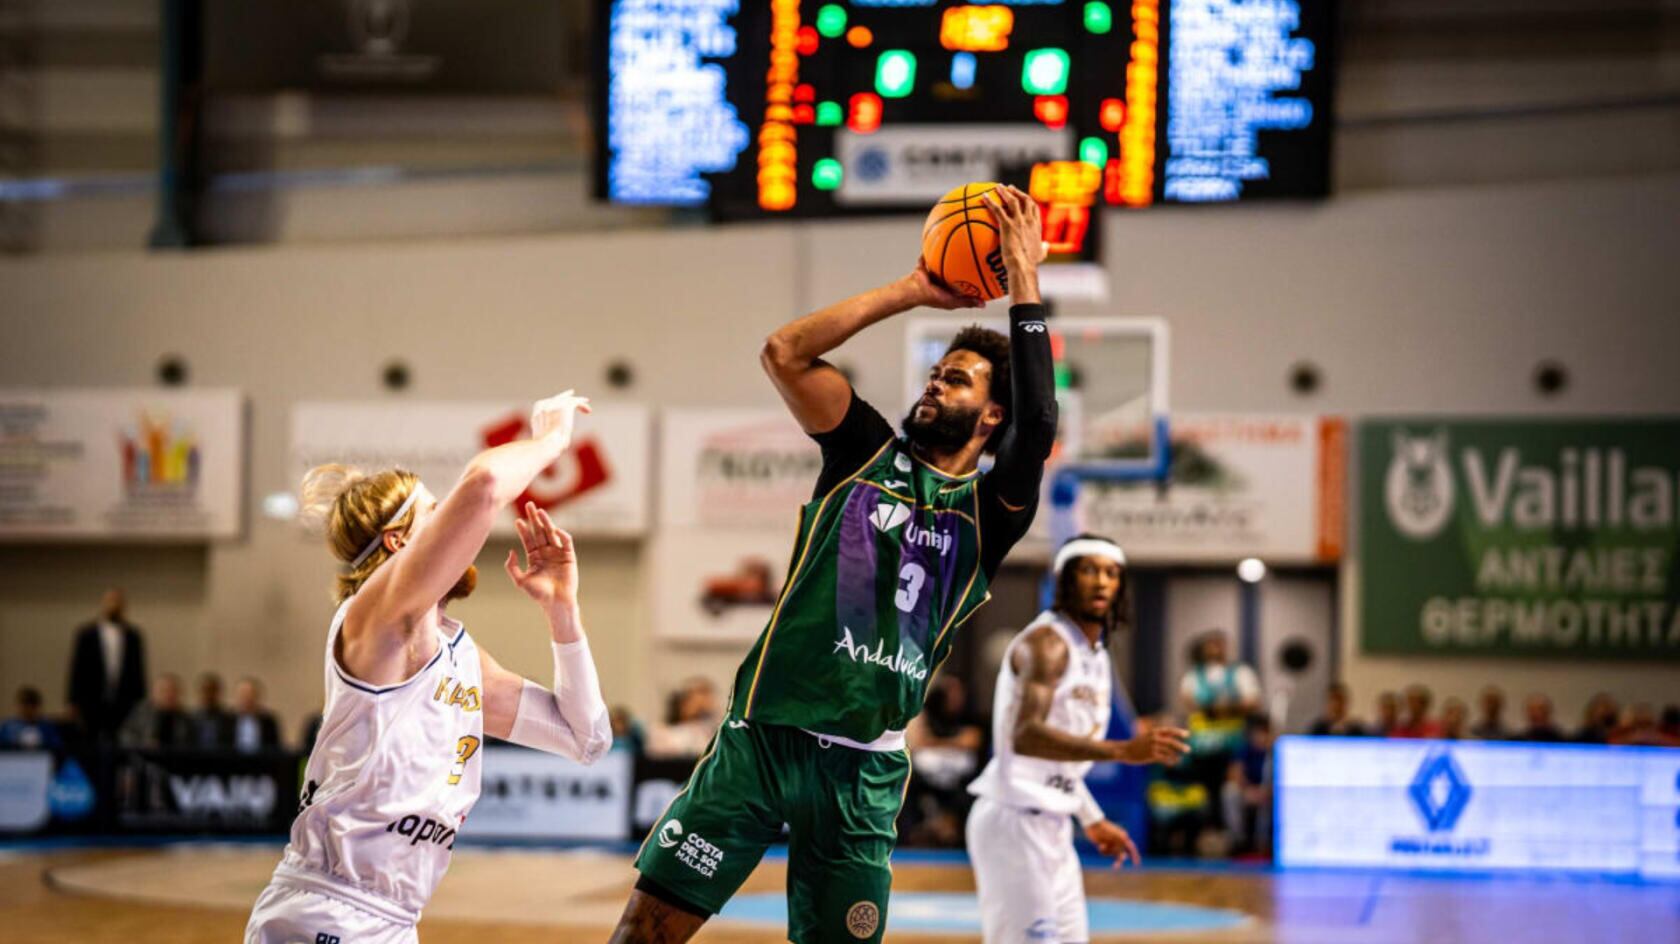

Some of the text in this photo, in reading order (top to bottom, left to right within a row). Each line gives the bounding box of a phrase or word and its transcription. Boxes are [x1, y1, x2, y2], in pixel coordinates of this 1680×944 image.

[1462, 447, 1680, 528] Vailla
[895, 562, 926, 613] 3
[680, 841, 718, 871] DEL SOL
[687, 832, 724, 862] COSTA
